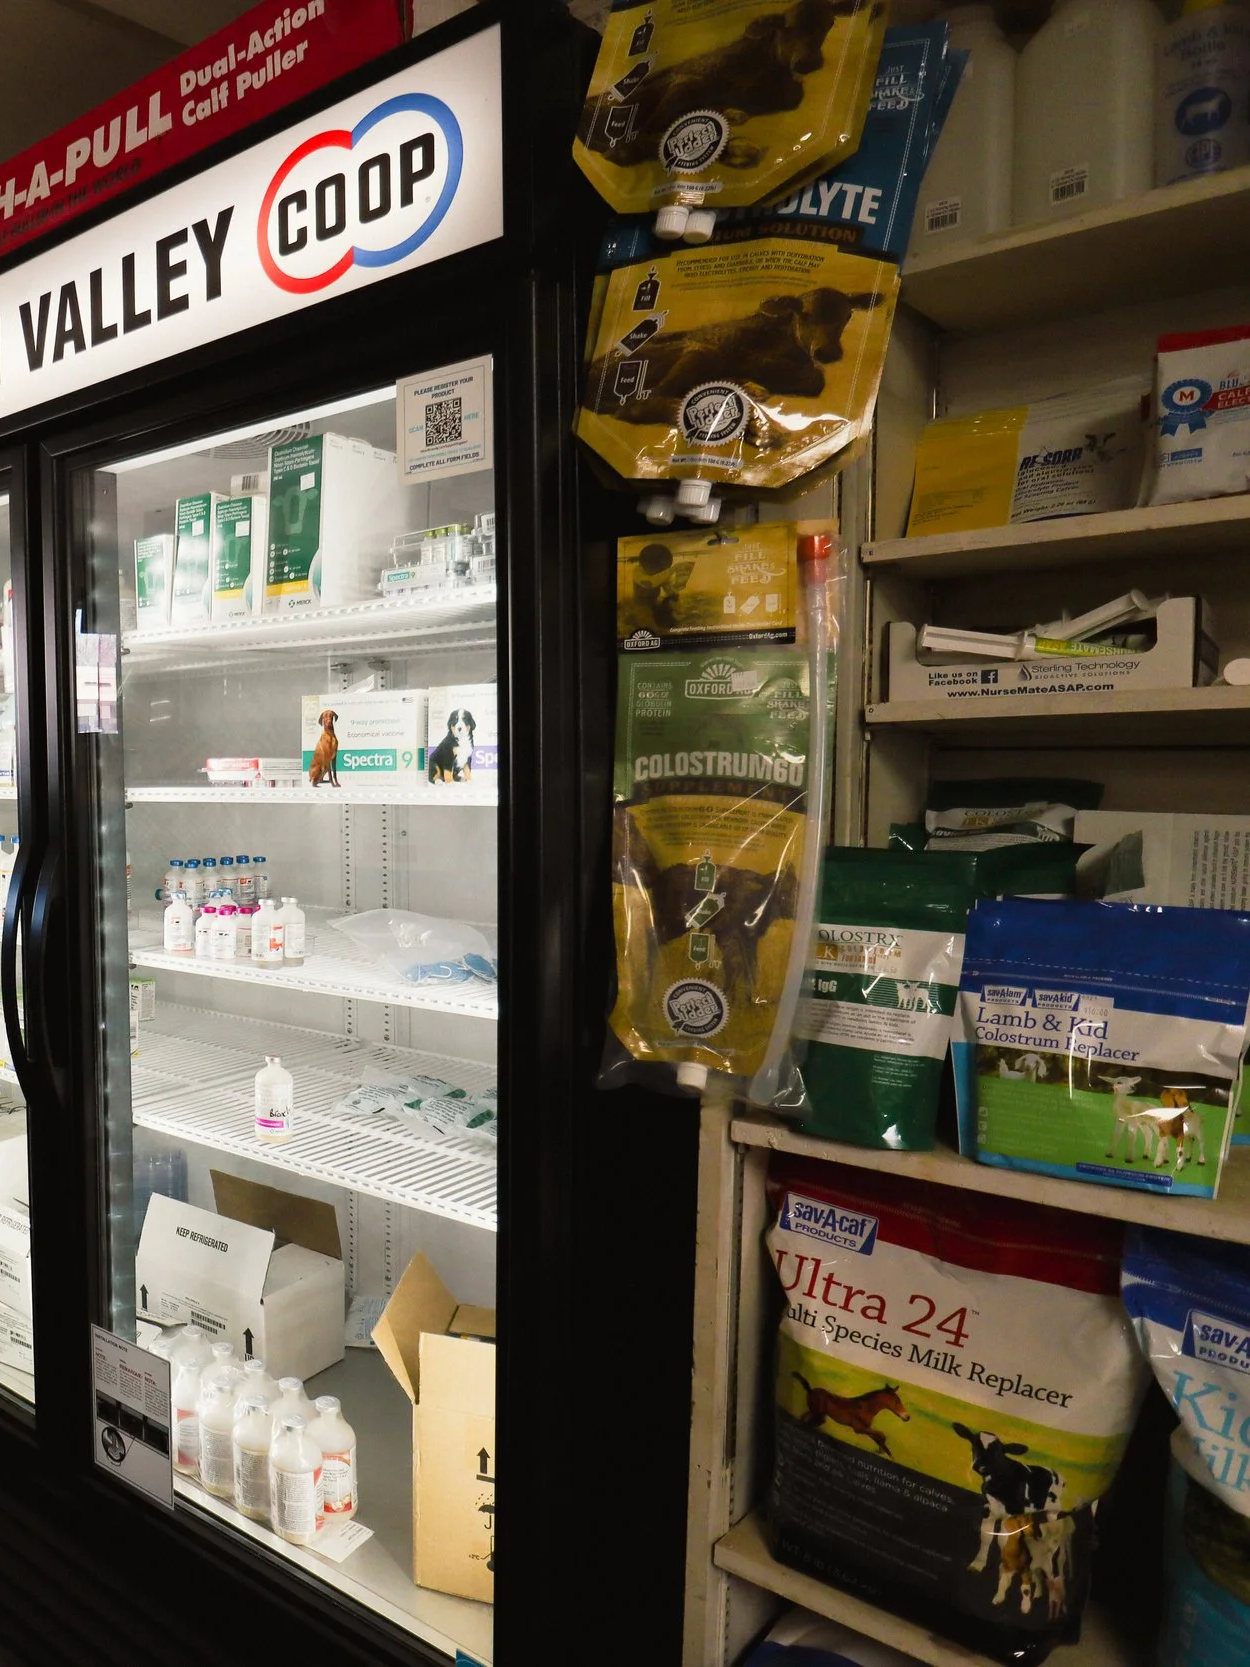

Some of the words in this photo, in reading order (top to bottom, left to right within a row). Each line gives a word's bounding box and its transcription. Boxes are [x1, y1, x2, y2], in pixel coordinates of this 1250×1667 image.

[179, 0, 326, 98] Dual-Action
[885, 65, 904, 74] JUST
[182, 83, 230, 128] Calf
[236, 38, 309, 101] Puller
[876, 74, 907, 87] FILL
[871, 85, 911, 100] HAKE
[667, 122, 715, 151] Perfect
[674, 132, 718, 157] Udder
[761, 221, 857, 242] SOLUTION
[17, 203, 235, 373] VALLEY
[277, 132, 435, 257] COOP
[640, 294, 651, 302] Fill
[629, 331, 648, 340] Shake
[413, 386, 433, 397] PLEASE
[434, 380, 458, 391] REGISTER
[459, 376, 474, 385] YOUR
[620, 375, 636, 384] Feed
[431, 388, 455, 399] PRODUCT
[690, 388, 730, 406] CONVENIENT
[1179, 390, 1195, 402] M
[687, 394, 736, 422] Perfect
[409, 460, 435, 471] COMPLETE
[446, 456, 461, 464] FORM
[461, 451, 480, 461] FIELDS
[734, 552, 766, 562] FILL
[387, 572, 409, 581] Spectra
[731, 574, 772, 585] FEED
[748, 631, 788, 640] OxfordAg.com
[1032, 664, 1072, 674] Sterling
[1074, 660, 1141, 673] Technology
[1034, 672, 1079, 680] BIOACTIVE
[1082, 670, 1130, 678] SOLUTIONS
[637, 682, 672, 690] CONTAINS
[928, 678, 978, 686] Facebook
[947, 682, 1114, 698] www.NurseMateASAP.com
[636, 699, 672, 708] GLOBULIN
[350, 718, 368, 726] 9-way
[369, 717, 401, 726] protection
[635, 708, 671, 718] PROTEIN
[382, 730, 405, 738] vaccine
[343, 753, 393, 769] Spectra
[401, 751, 413, 768] 9
[818, 979, 838, 993] IgG
[670, 993, 712, 1016] Perfect
[679, 1004, 718, 1021] Udder
[1038, 1002, 1073, 1010] PRODUCTS
[976, 1006, 1036, 1029] Lamb
[1046, 1014, 1062, 1032] &
[1070, 1017, 1108, 1040] Kid
[975, 1026, 1060, 1050] Colostrum
[1064, 1038, 1141, 1062] Replacer
[175, 1226, 190, 1238] KEEP
[190, 1232, 229, 1252] REFRIGERATED
[794, 1222, 858, 1248] PRODUCTS
[774, 1248, 888, 1326] Ultra
[902, 1293, 970, 1348] 24
[94, 1332, 118, 1349] INSTALLATION
[118, 1344, 128, 1354] NOTE
[824, 1316, 903, 1358] Species
[907, 1344, 964, 1378] Milk
[968, 1362, 1074, 1410] Replacer
[1193, 1434, 1250, 1492] ilk
[857, 1460, 900, 1482] nutrition
[902, 1474, 916, 1488] for
[874, 1476, 902, 1494] llama
[903, 1489, 911, 1498] &
[914, 1494, 950, 1513] alpaca
